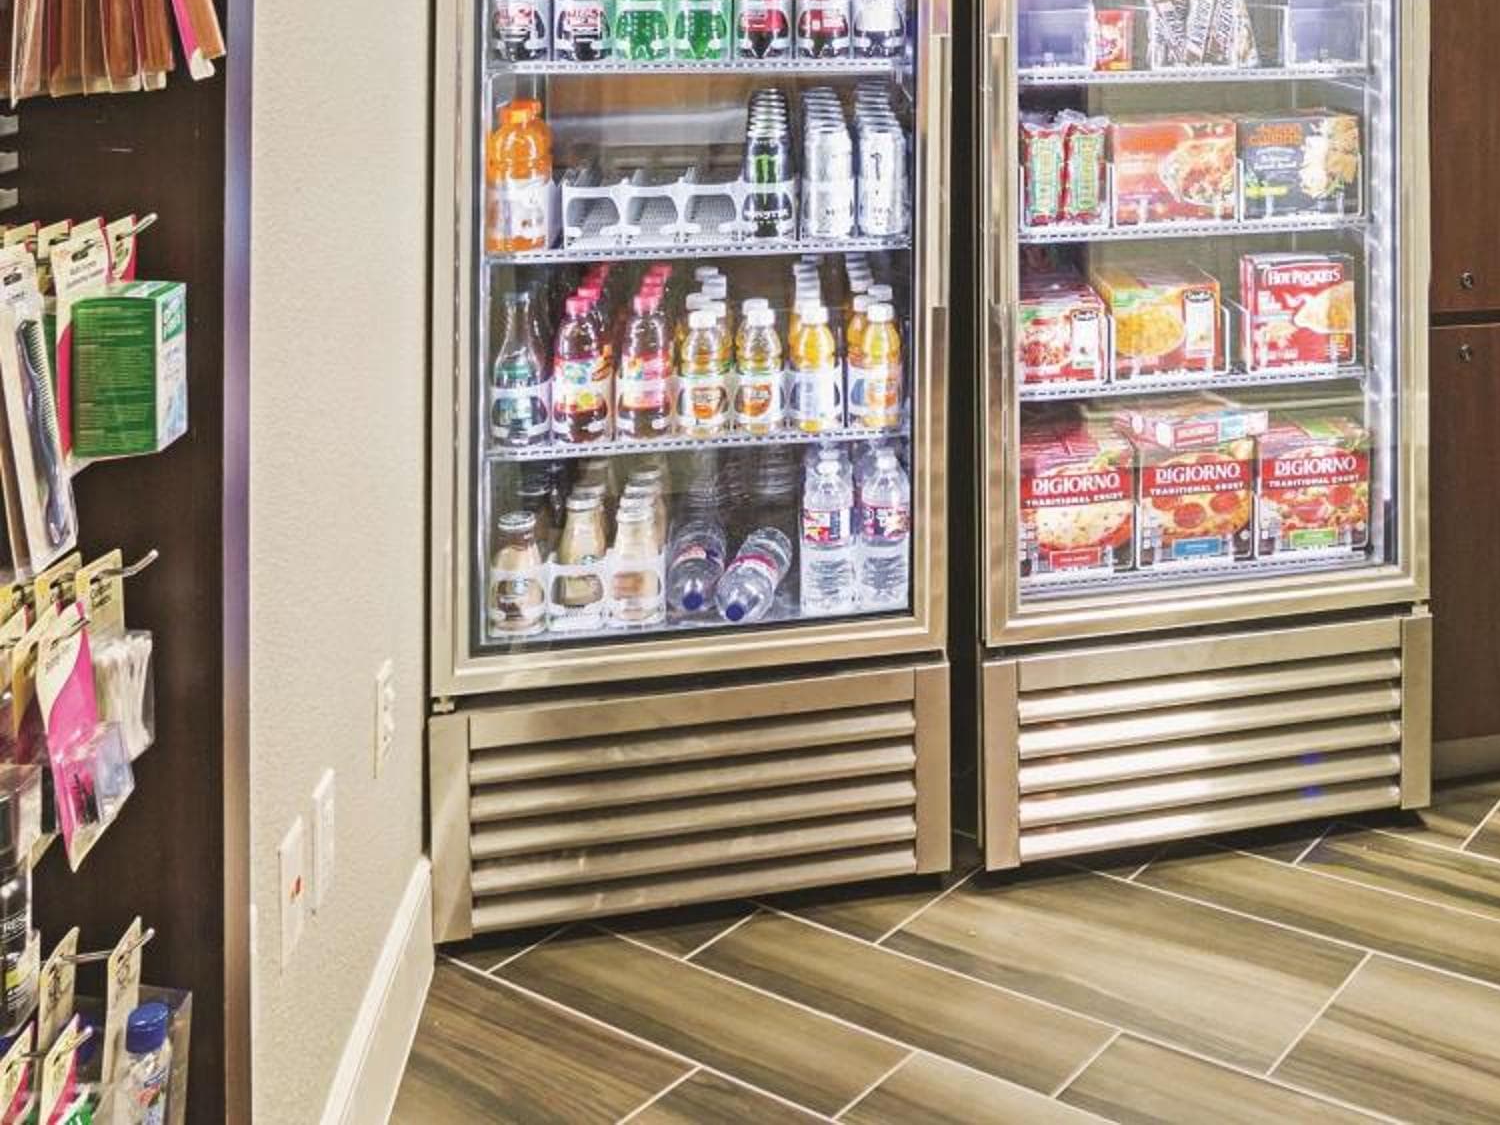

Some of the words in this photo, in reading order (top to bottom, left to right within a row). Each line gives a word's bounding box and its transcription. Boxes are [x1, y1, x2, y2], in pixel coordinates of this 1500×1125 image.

[1155, 461, 1242, 484] DIGIORNO
[1273, 455, 1358, 477] DIGIORNO
[1031, 472, 1121, 496] DIGIORNO
